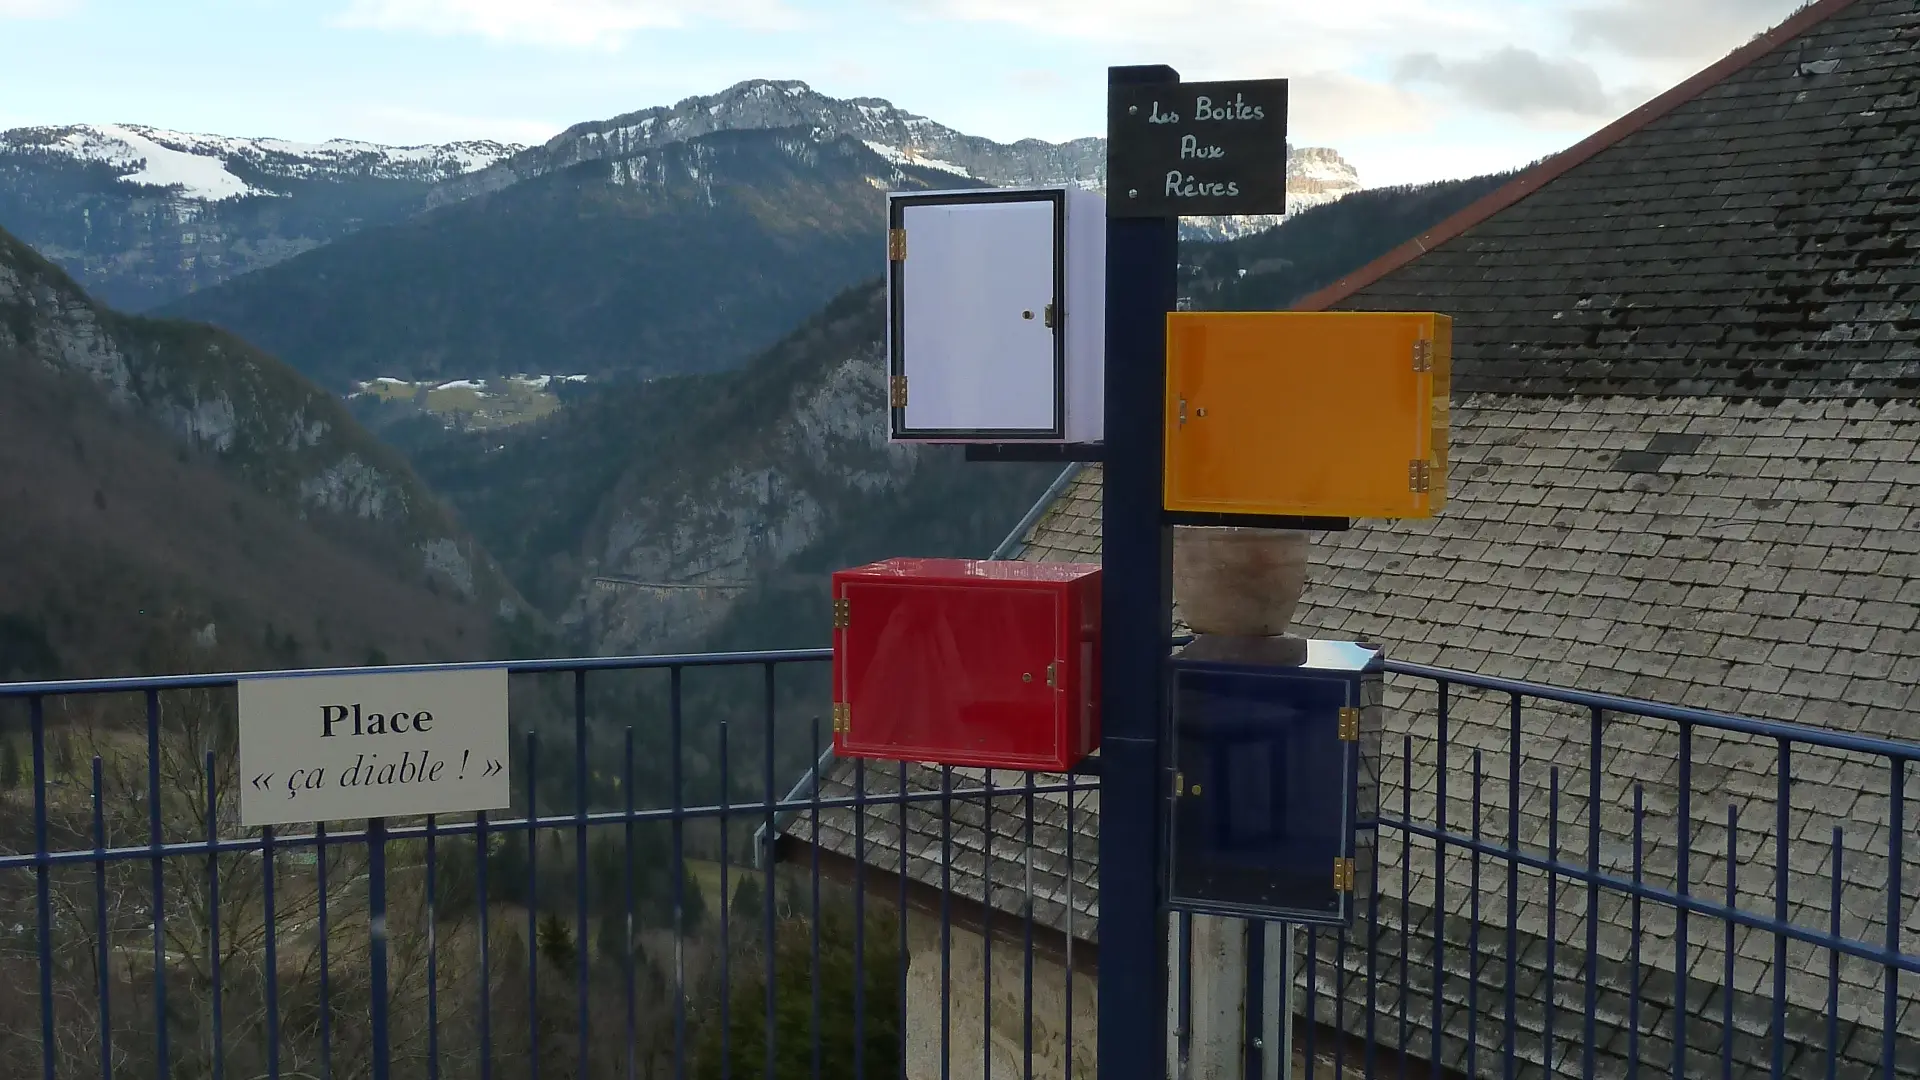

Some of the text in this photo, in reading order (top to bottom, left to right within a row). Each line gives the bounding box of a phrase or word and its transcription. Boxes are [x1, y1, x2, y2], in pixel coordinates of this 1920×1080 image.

[1149, 92, 1265, 124] Les Boites
[1180, 134, 1225, 160] Aux
[1165, 170, 1239, 197] Rêves
[319, 703, 434, 738] Place
[287, 766, 325, 799] ça
[339, 750, 444, 788] diable
[458, 749, 470, 780] !
